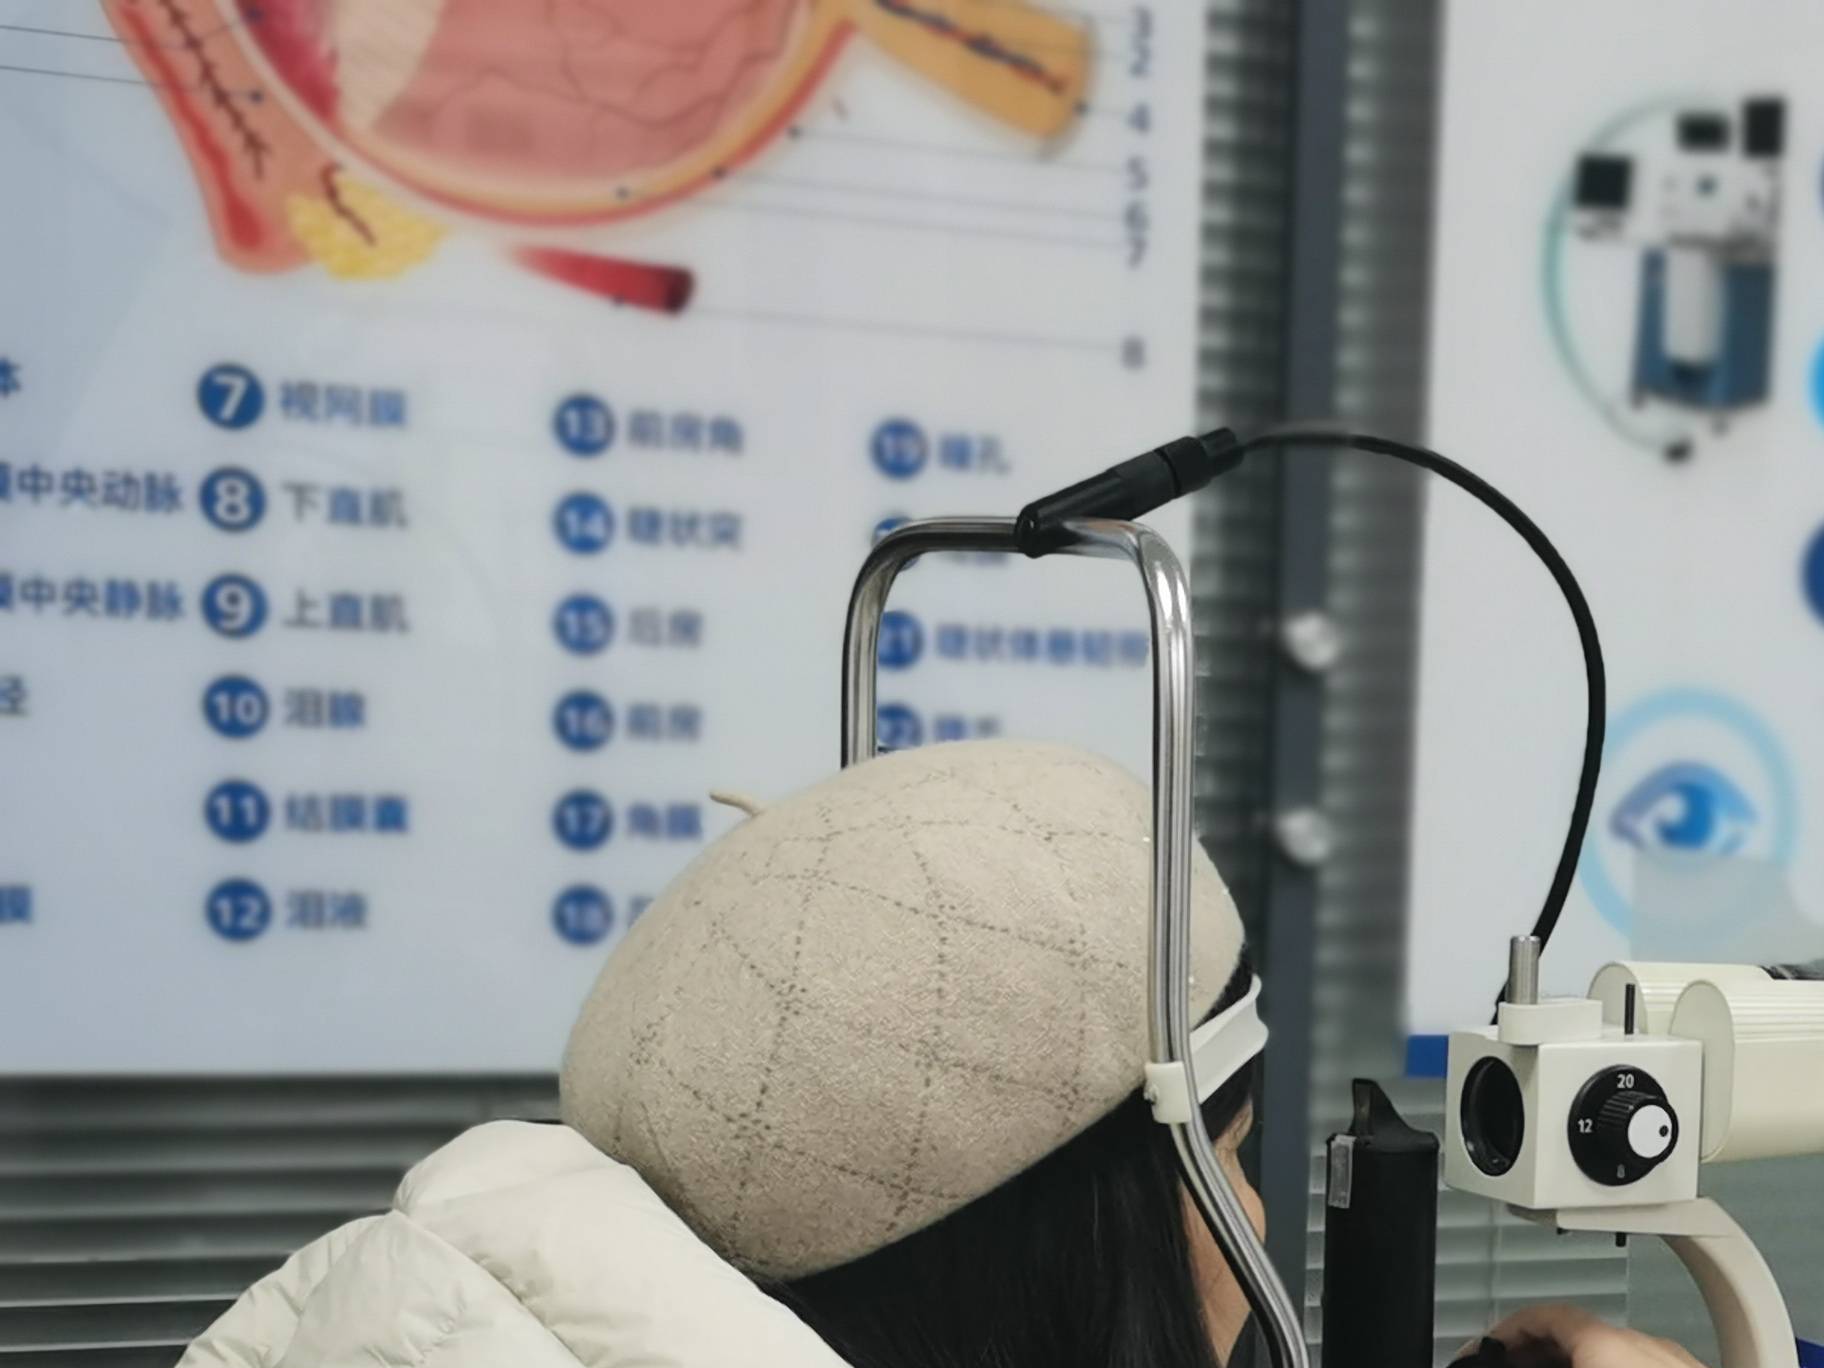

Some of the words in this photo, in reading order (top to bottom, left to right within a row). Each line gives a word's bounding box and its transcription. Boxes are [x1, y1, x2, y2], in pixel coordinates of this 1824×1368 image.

[212, 373, 247, 421] 7
[0, 463, 183, 513] 中央动脉
[214, 478, 249, 523] 8
[280, 478, 409, 529] 下直肌
[215, 584, 253, 630] 9
[280, 587, 410, 632] 上直肌
[212, 690, 261, 727] 10
[212, 796, 258, 829] 11
[214, 897, 262, 931] 12
[1616, 1073, 1635, 1089] 20
[1577, 1118, 1593, 1134] 12
